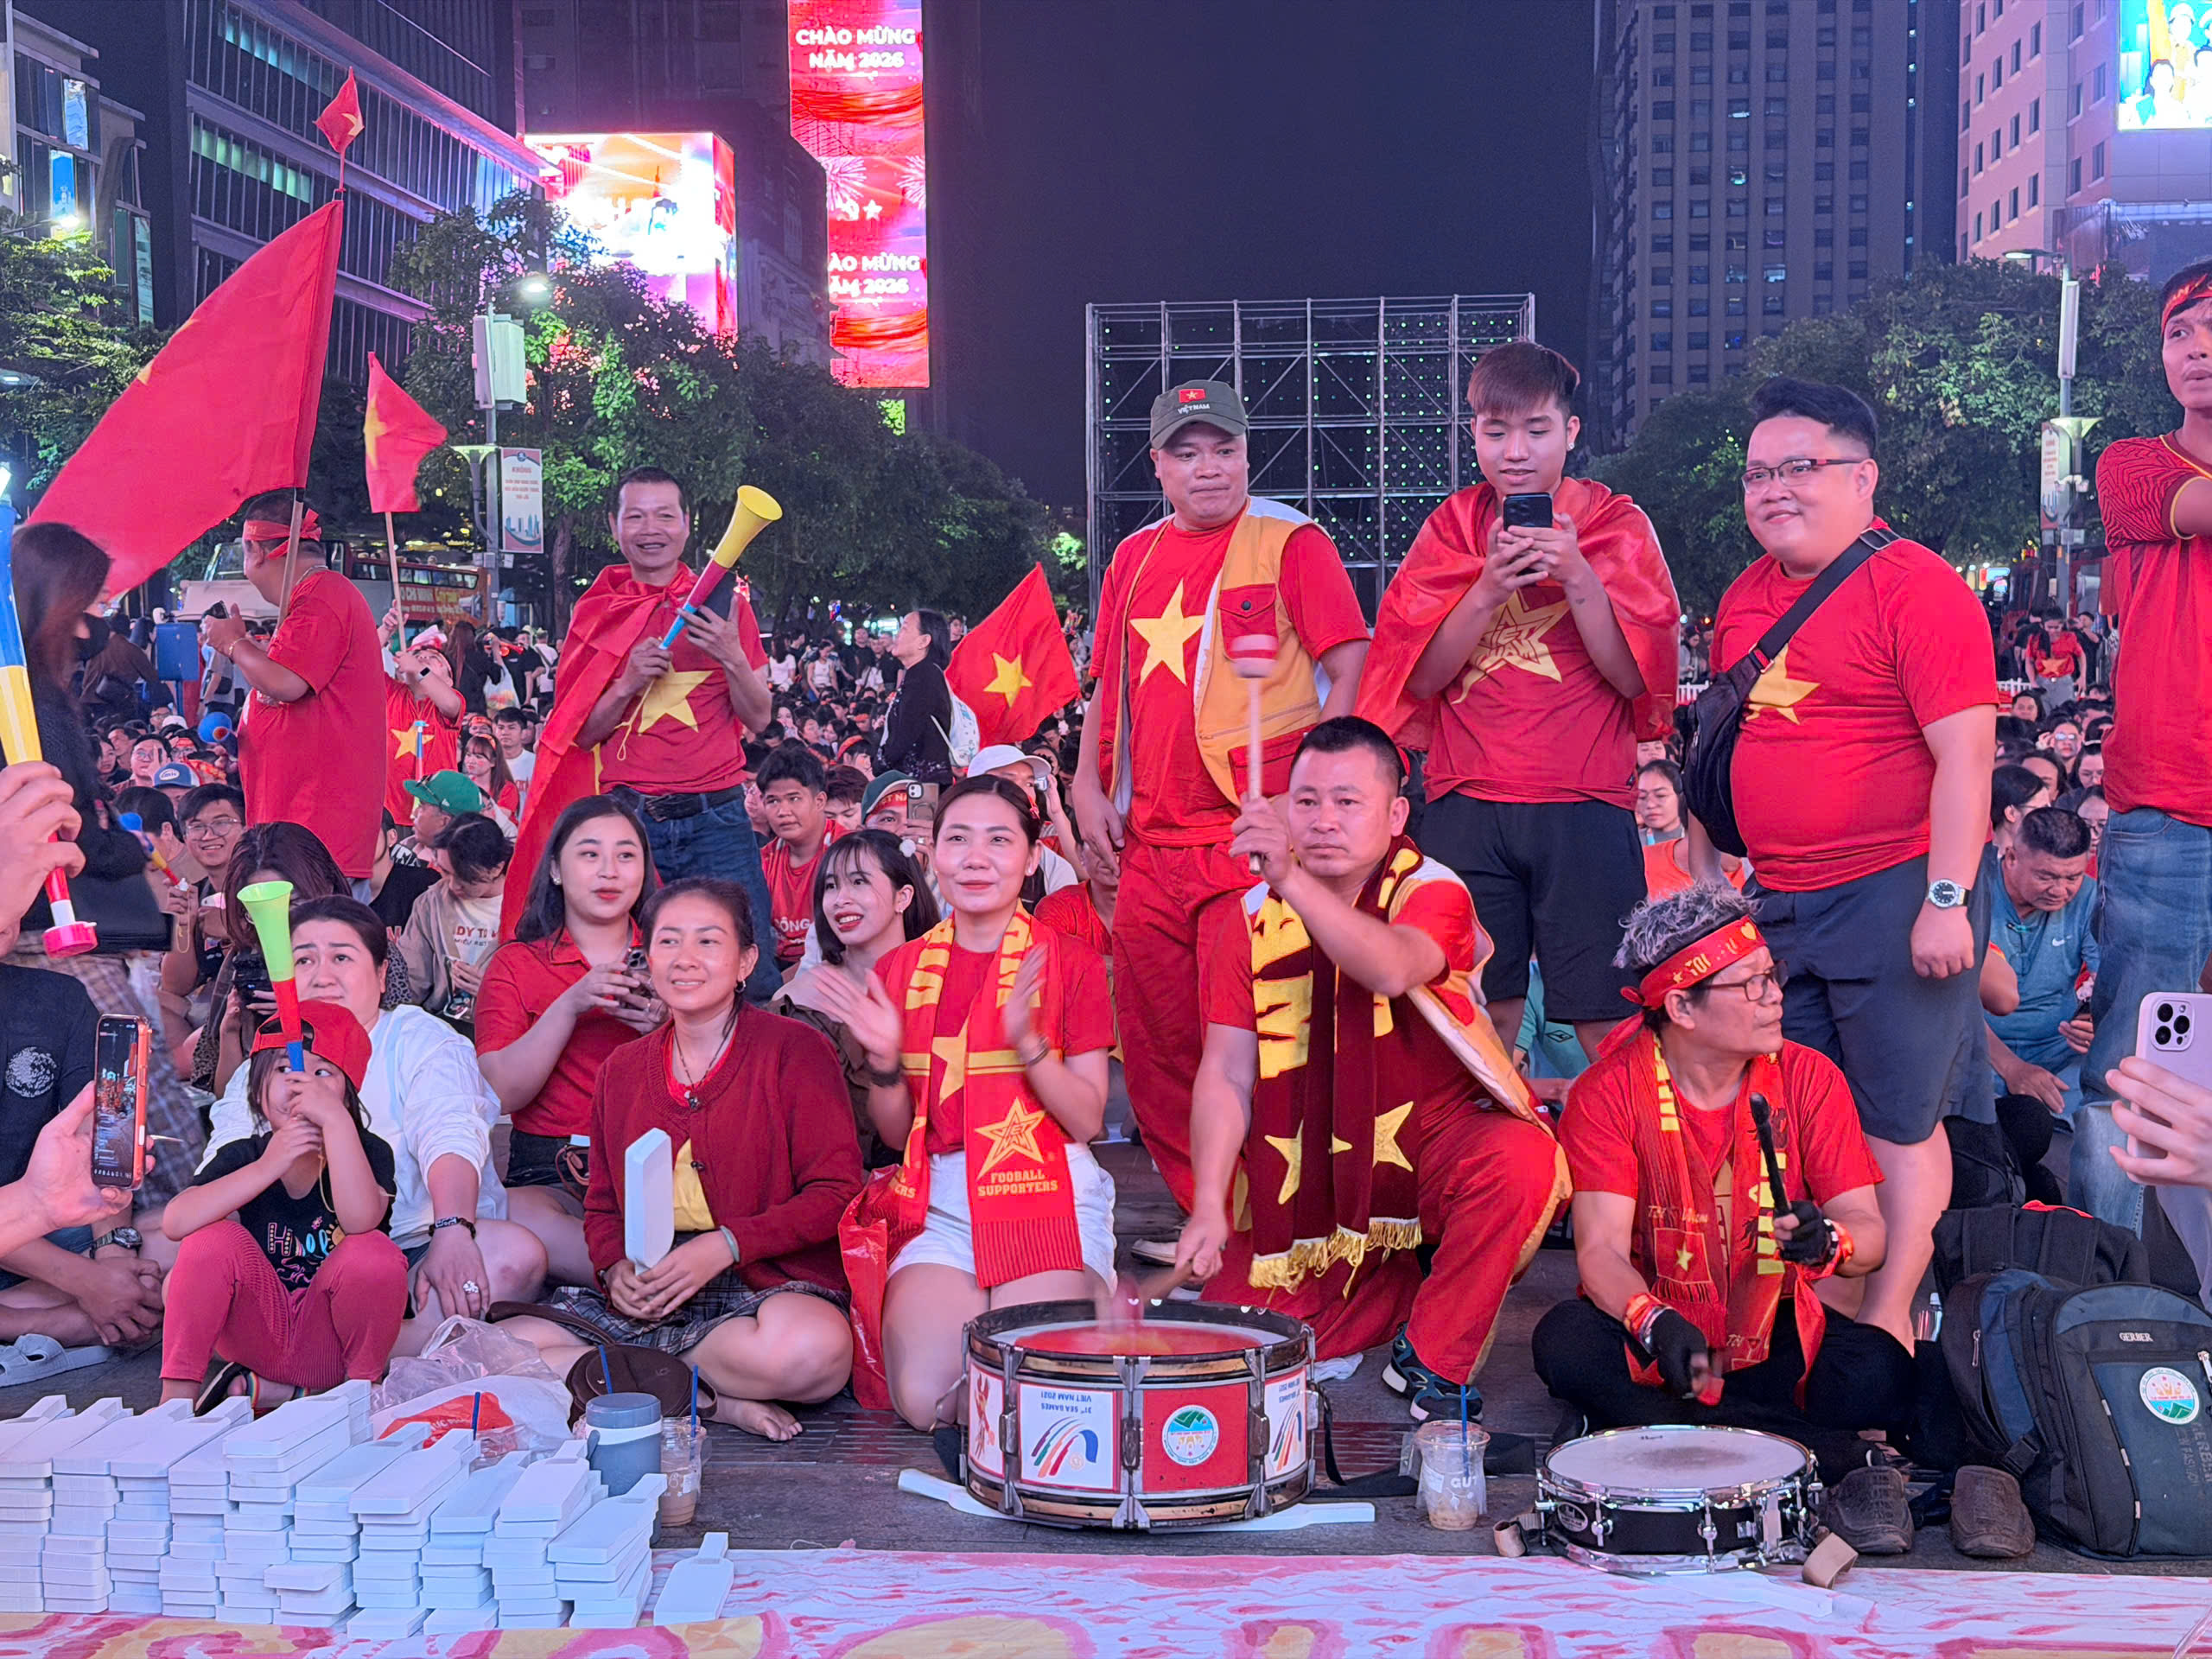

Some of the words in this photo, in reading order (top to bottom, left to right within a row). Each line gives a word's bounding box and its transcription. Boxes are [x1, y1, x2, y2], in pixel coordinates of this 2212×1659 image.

[795, 25, 853, 45] CHÀO
[856, 25, 916, 45] MỪNG
[809, 49, 856, 71] NĂM
[858, 52, 906, 68] 2026
[828, 251, 857, 271] ÀO
[861, 251, 920, 271] MỪNG
[829, 275, 861, 297] ĂM
[862, 277, 910, 295] 2026
[990, 1169, 1046, 1185] FOOBALL
[977, 1179, 1059, 1197] SUPPORTERS
[2119, 1332, 2154, 1342] GERBER
[1040, 1402, 1065, 1412] GAMES
[1065, 1405, 1079, 1414] SEA
